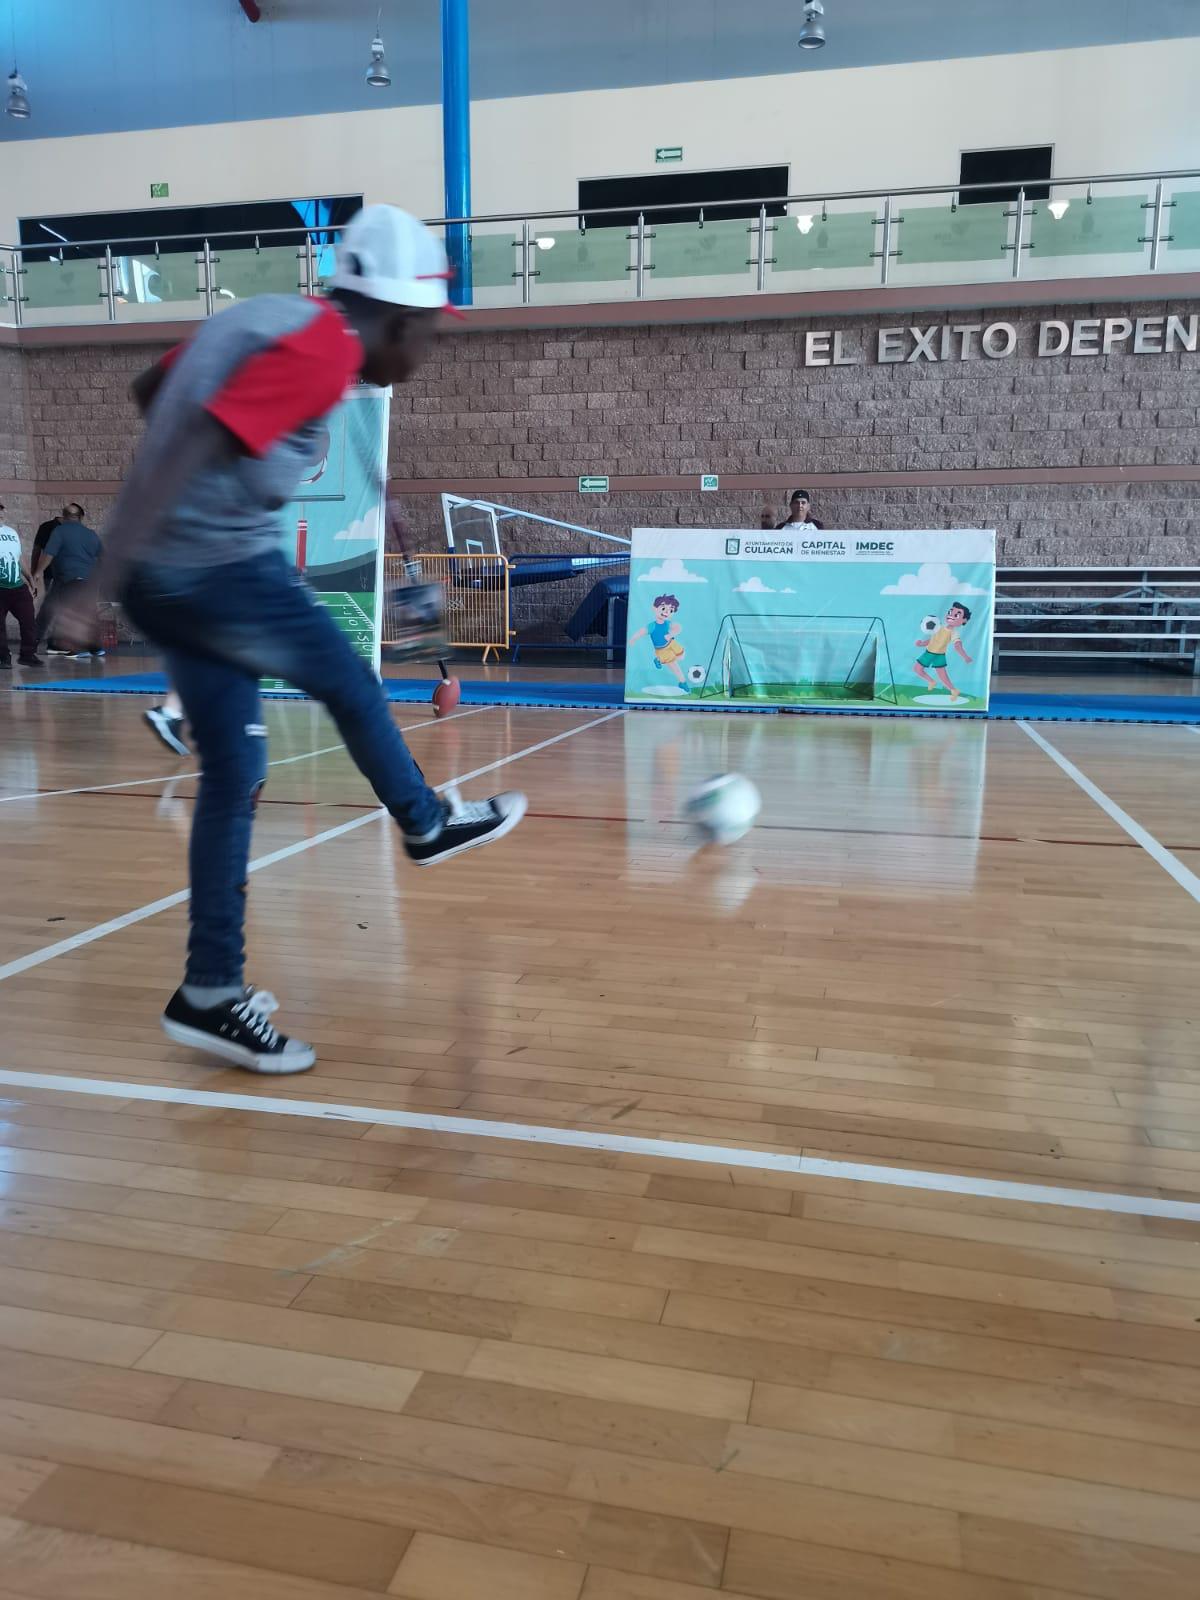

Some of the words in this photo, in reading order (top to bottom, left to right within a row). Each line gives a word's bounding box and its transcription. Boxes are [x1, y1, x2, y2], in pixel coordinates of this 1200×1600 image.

[805, 331, 857, 367] EL
[877, 321, 1017, 364] EXITO
[1038, 315, 1199, 357] DEPEN
[801, 541, 846, 549] CAPITAL
[855, 541, 894, 551] IMDEC
